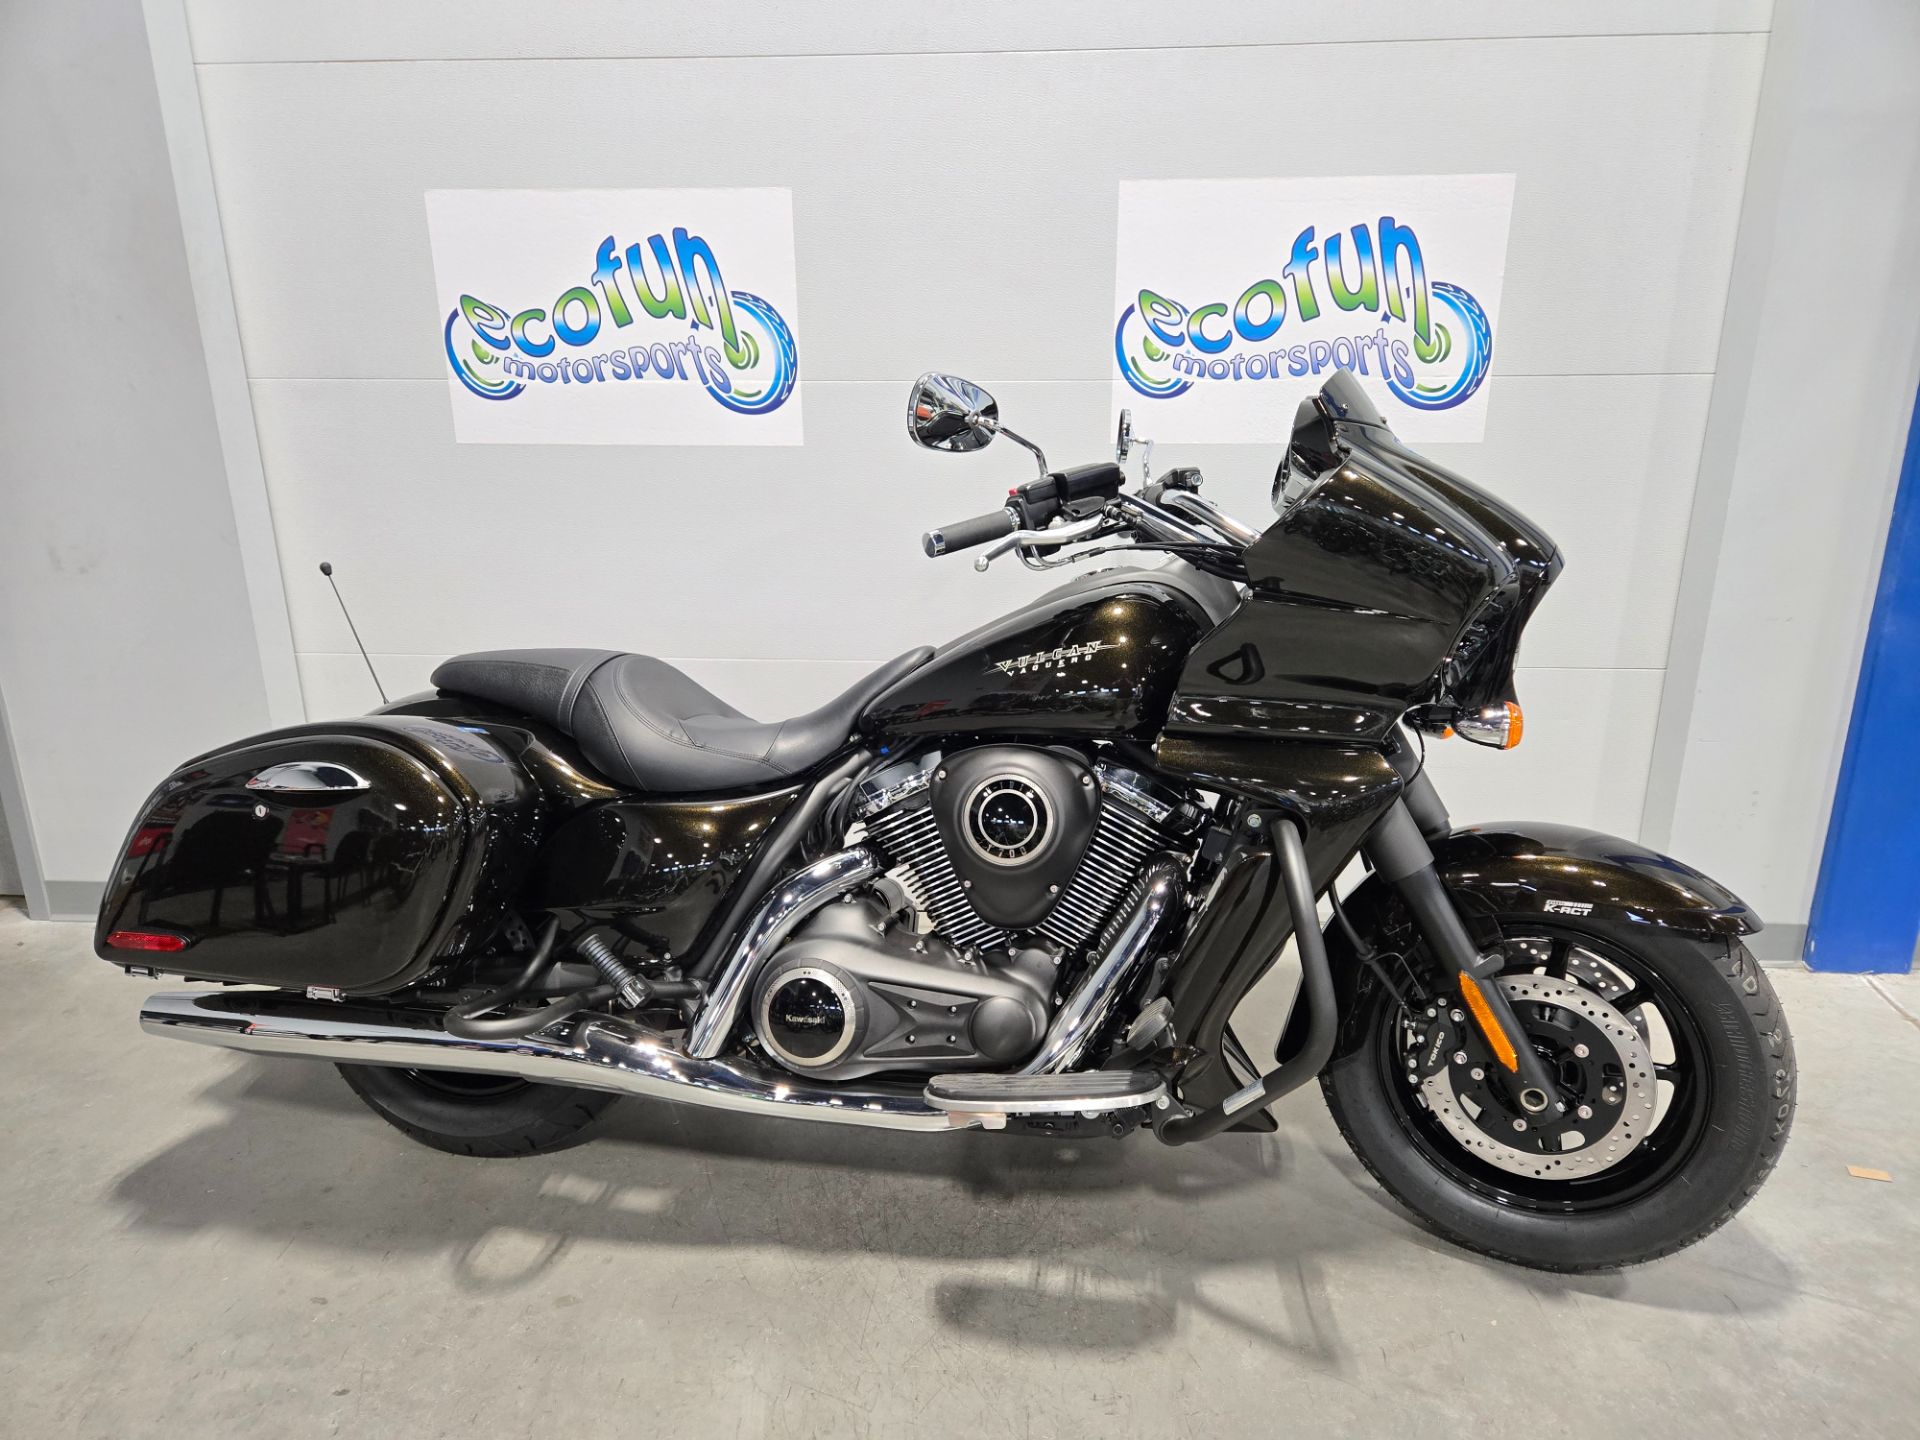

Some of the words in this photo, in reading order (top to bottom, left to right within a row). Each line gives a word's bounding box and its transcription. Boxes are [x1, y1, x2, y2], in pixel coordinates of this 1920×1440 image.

[460, 227, 740, 353] ecofun
[1139, 216, 1432, 346] ecofun
[503, 335, 733, 395] motorsports
[1173, 328, 1415, 390] motorsports
[994, 640, 1102, 672] VULCAN
[1006, 655, 1092, 677] VAQUERO
[1543, 903, 1592, 916] K-ACT
[1427, 1031, 1445, 1067] TOKICO
